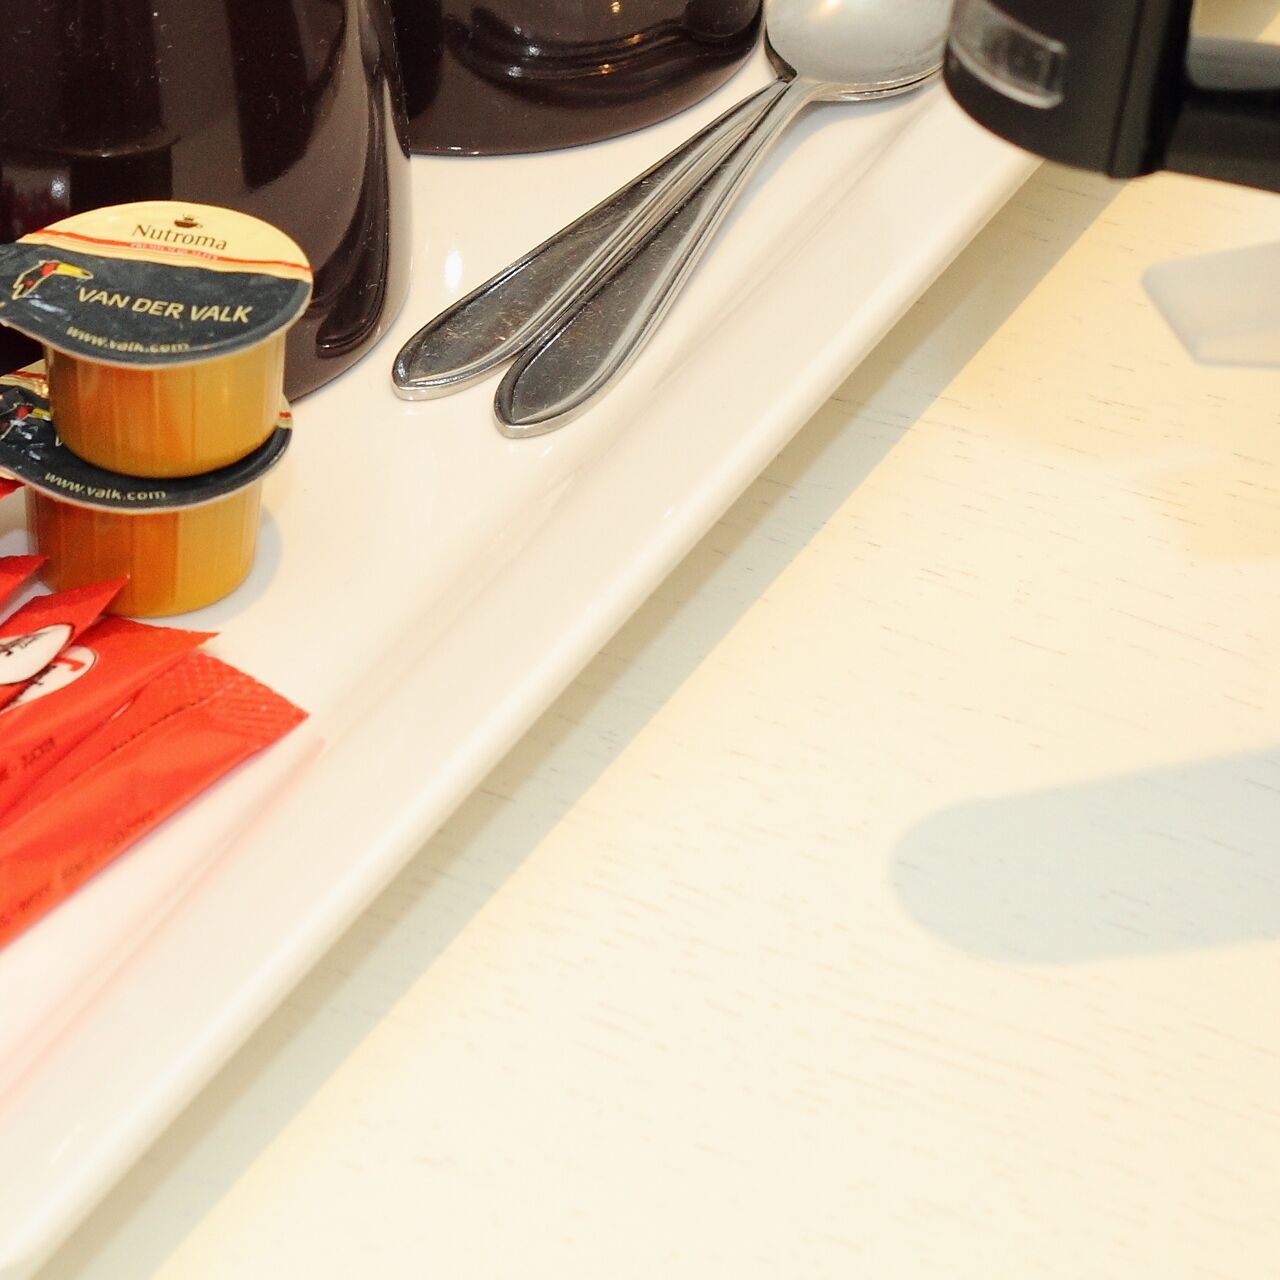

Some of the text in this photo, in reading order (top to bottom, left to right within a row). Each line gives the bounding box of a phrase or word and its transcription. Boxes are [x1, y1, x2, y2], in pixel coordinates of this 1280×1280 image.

[132, 223, 227, 251] Nutroma
[78, 287, 253, 324] VAN DER VALK
[66, 326, 190, 353] www.valk.com
[45, 472, 166, 500] www.valk.com
